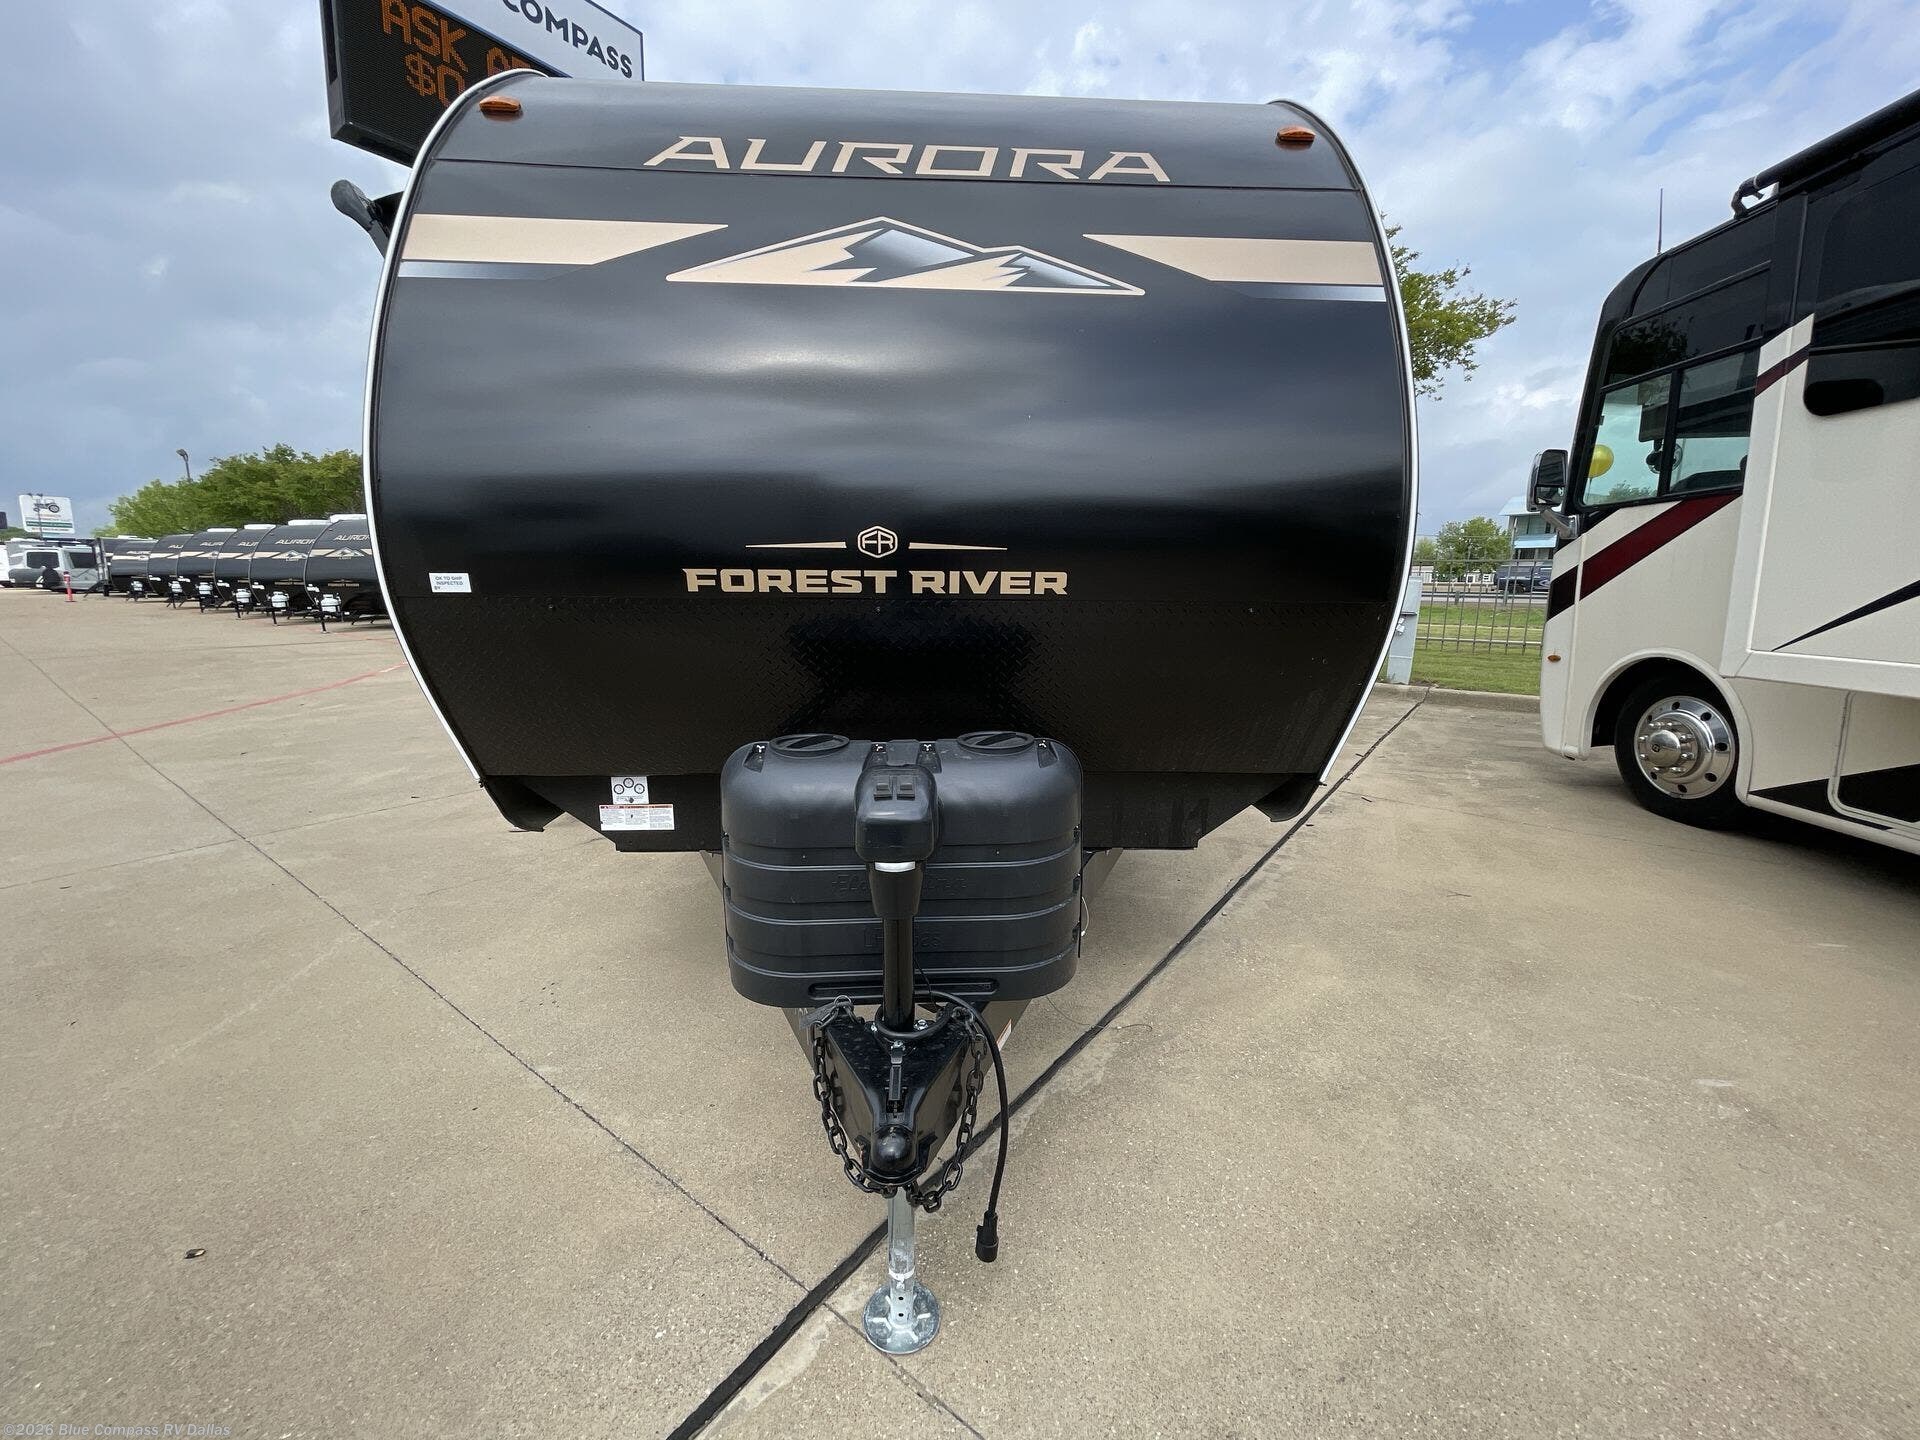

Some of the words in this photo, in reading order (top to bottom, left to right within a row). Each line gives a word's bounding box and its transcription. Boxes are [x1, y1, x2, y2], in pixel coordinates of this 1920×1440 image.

[380, 0, 469, 73] ASK
[643, 136, 1171, 183] AURORA
[682, 568, 897, 593] FOREST
[909, 570, 1068, 596] RIVER
